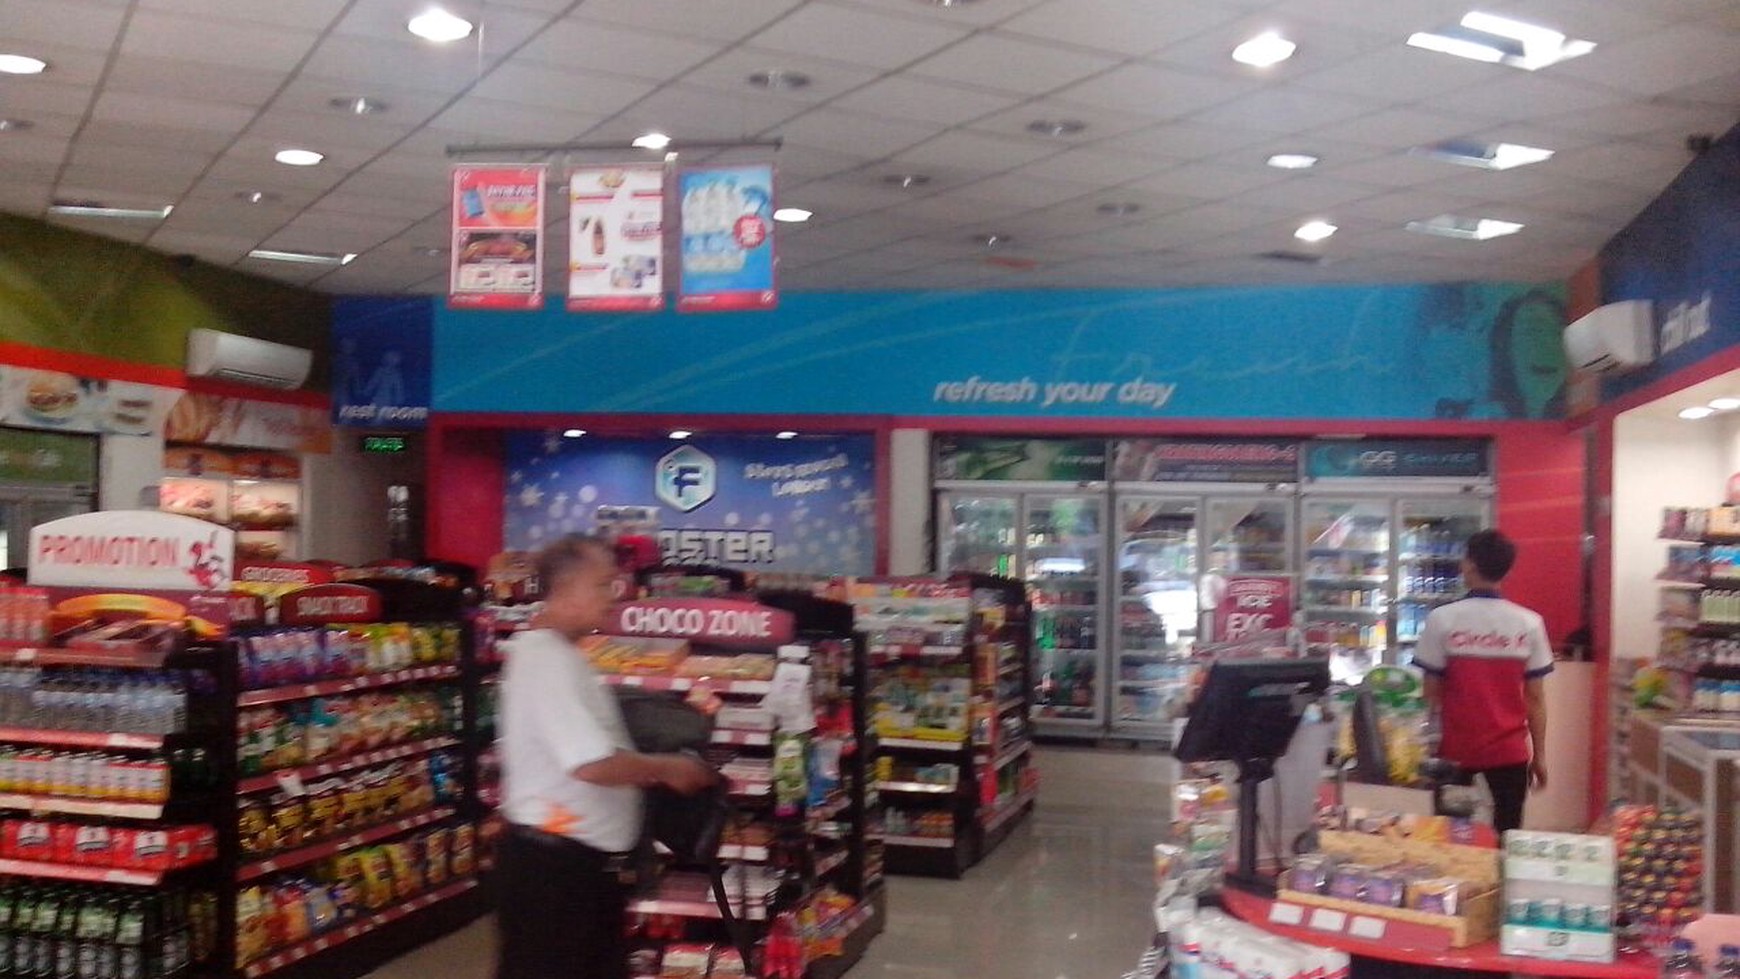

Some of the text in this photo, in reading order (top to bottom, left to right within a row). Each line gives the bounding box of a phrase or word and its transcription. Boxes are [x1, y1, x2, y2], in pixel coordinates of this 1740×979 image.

[934, 375, 1177, 409] refresh your day
[38, 535, 180, 567] PROMOTION
[620, 606, 772, 638] CHOCO ZONE
